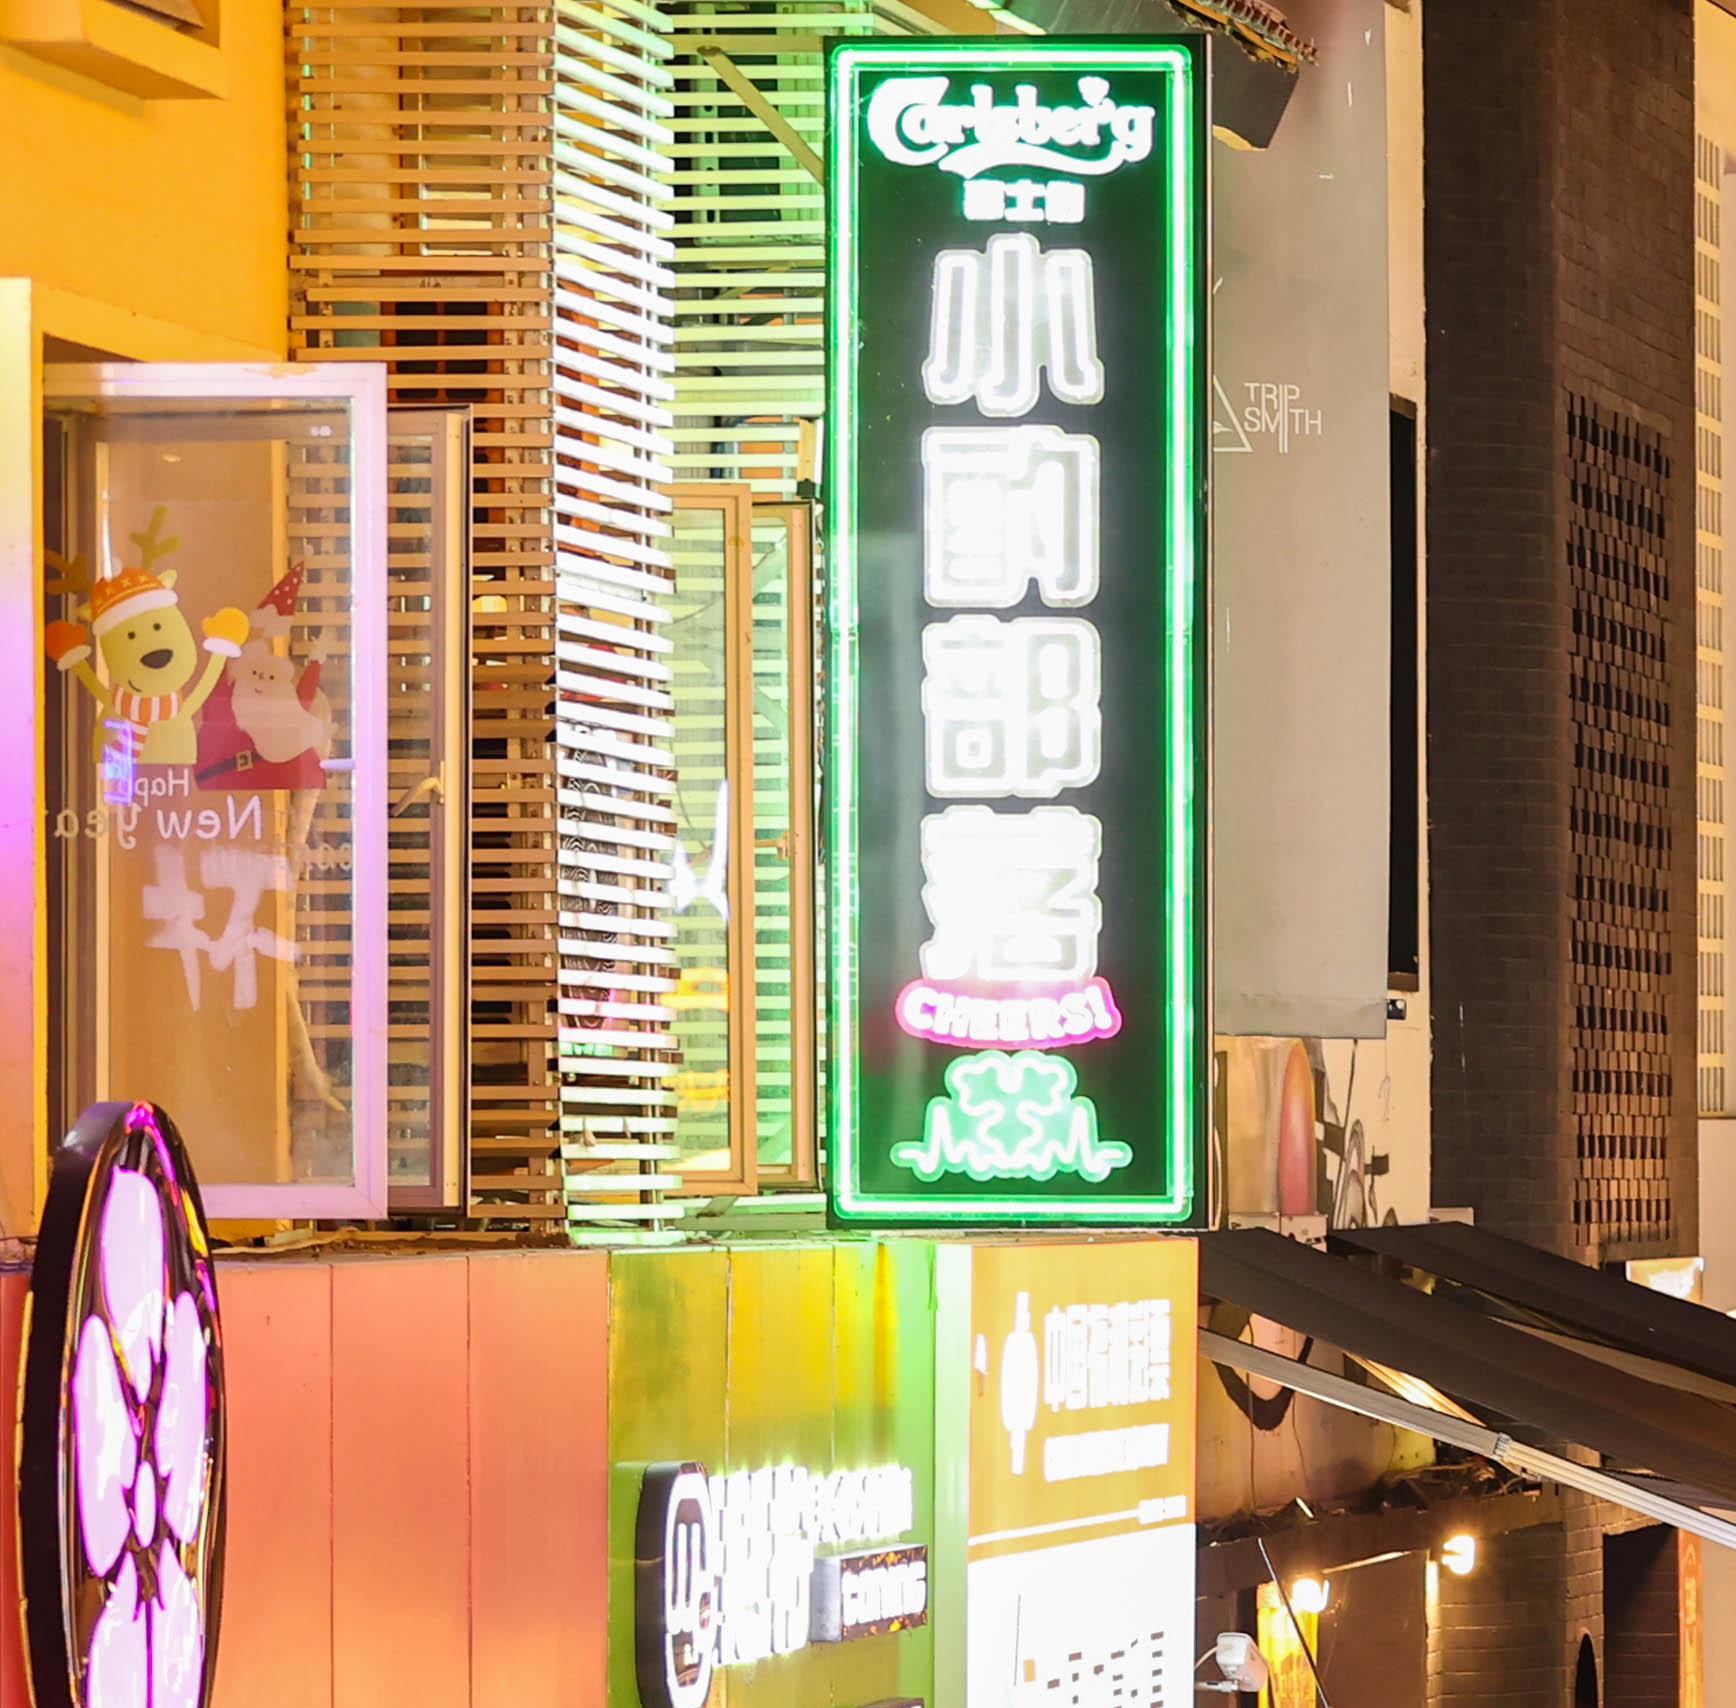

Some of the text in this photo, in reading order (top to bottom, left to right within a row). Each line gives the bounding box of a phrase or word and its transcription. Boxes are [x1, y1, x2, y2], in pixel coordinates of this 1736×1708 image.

[867, 76, 1156, 172] Carlsberg
[1243, 381, 1301, 408] TRIP
[1243, 407, 1322, 440] SMITH
[901, 984, 1115, 1042] CHEERS!
